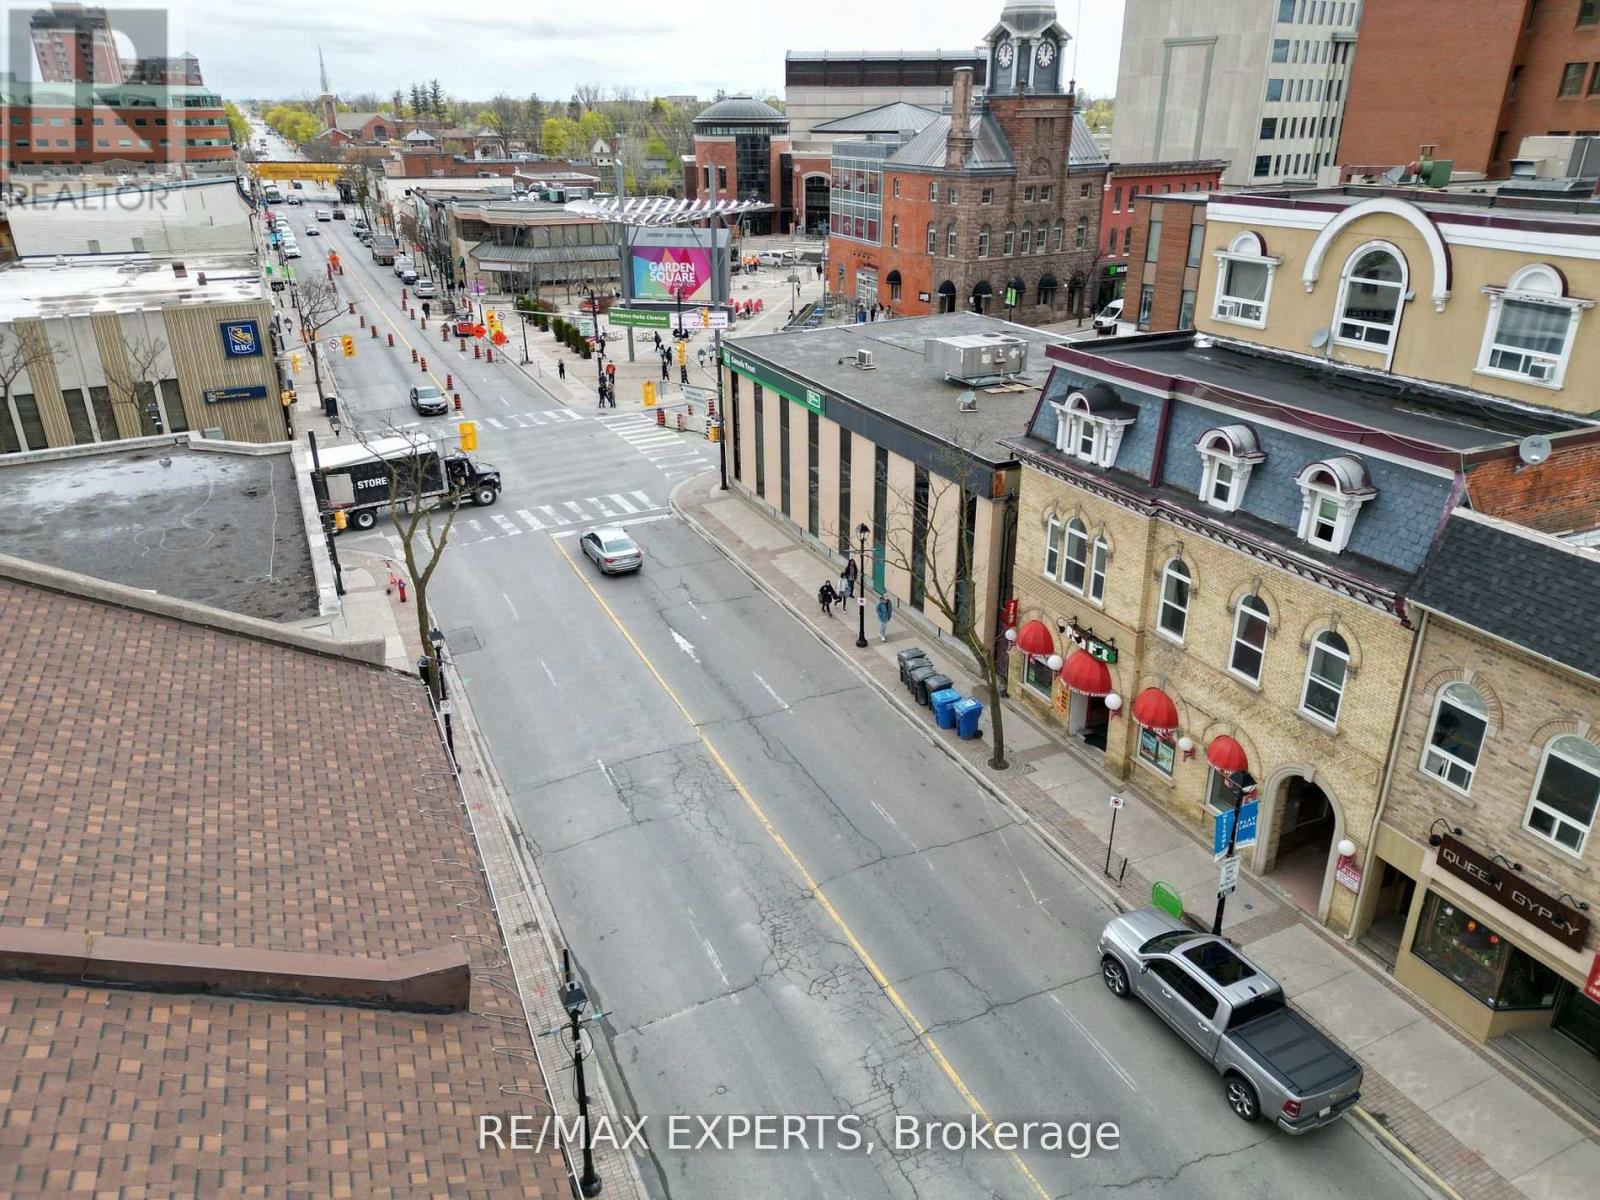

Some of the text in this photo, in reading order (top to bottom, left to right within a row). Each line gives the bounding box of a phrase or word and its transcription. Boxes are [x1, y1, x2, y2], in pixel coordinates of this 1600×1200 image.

[649, 262, 695, 273] GARDEN
[650, 272, 696, 283] SQUARE
[357, 476, 388, 490] STORE
